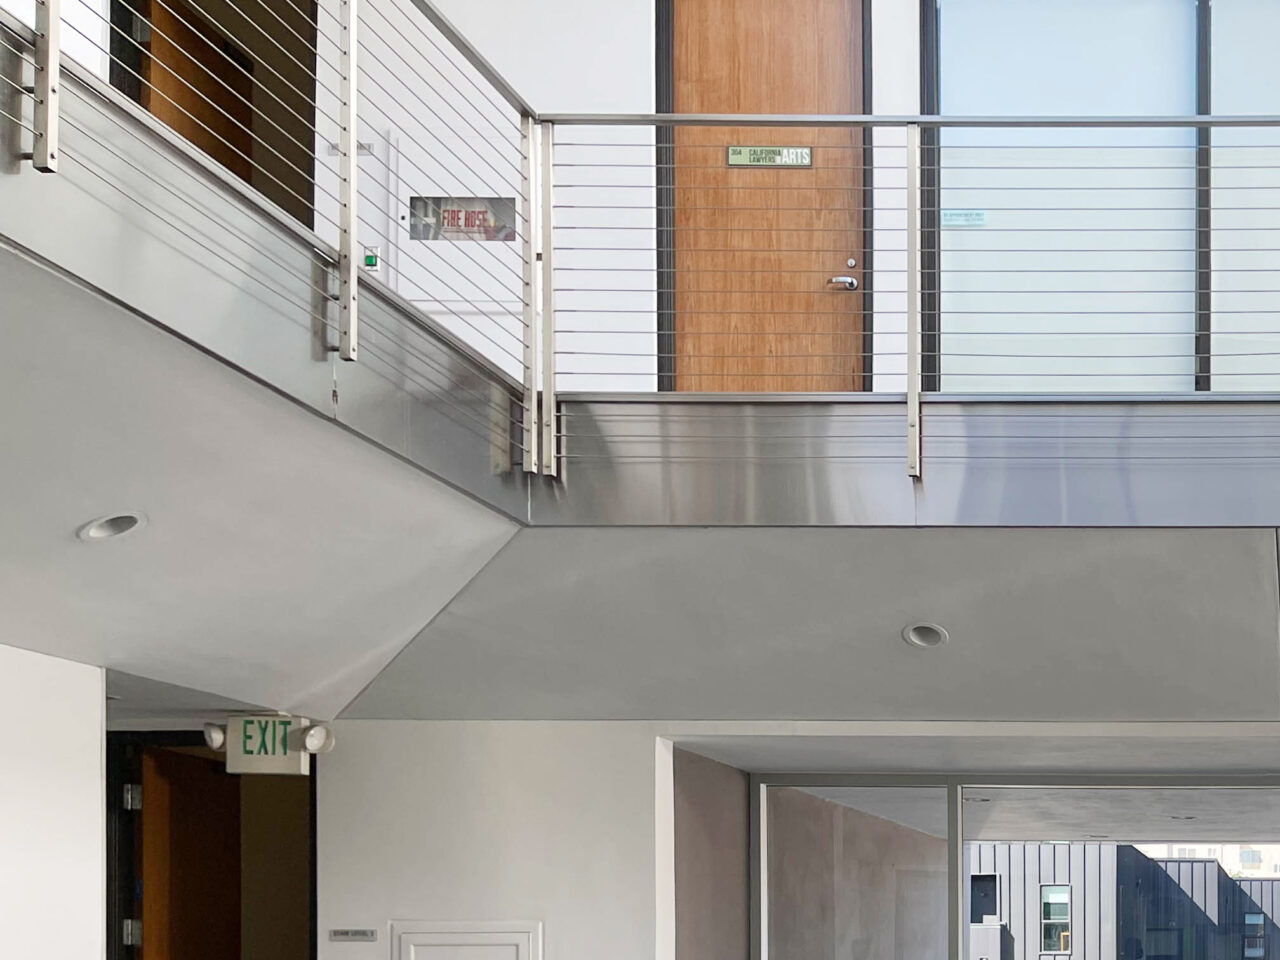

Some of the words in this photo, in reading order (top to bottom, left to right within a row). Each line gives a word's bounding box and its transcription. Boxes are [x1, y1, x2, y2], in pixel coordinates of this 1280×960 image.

[782, 148, 809, 164] ARTS
[442, 210, 462, 228] FIRE
[464, 210, 488, 228] HOSE
[242, 719, 292, 756] EXIT
